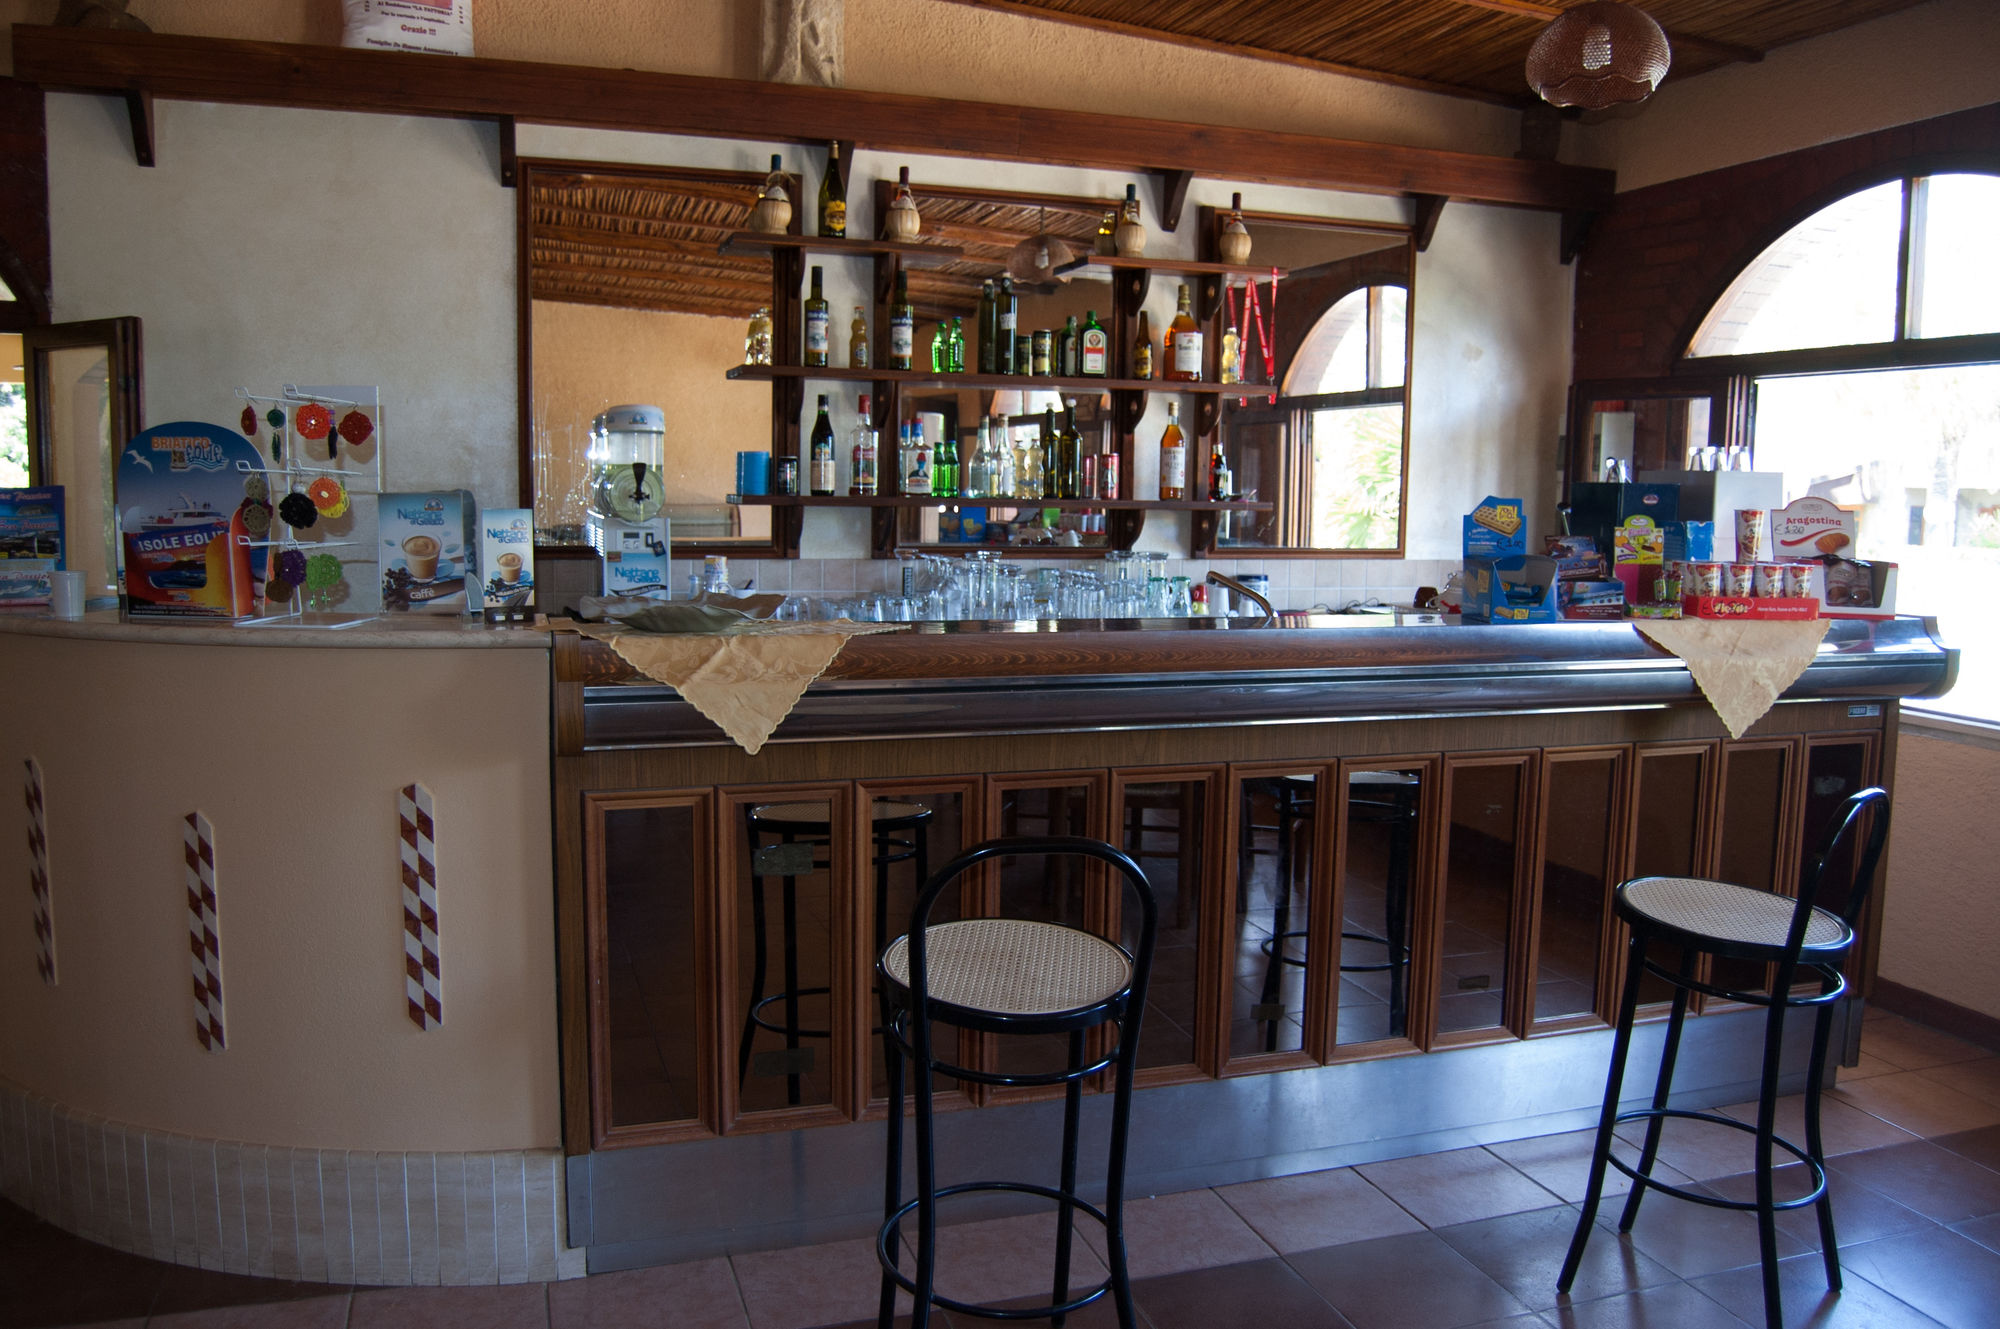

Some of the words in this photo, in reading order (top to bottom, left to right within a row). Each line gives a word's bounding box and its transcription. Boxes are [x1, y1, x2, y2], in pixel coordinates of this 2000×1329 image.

[401, 24, 427, 34] Grazie
[152, 437, 210, 449] BRIATICO
[1786, 516, 1842, 526] Aragostina
[138, 537, 181, 551] ISOLE
